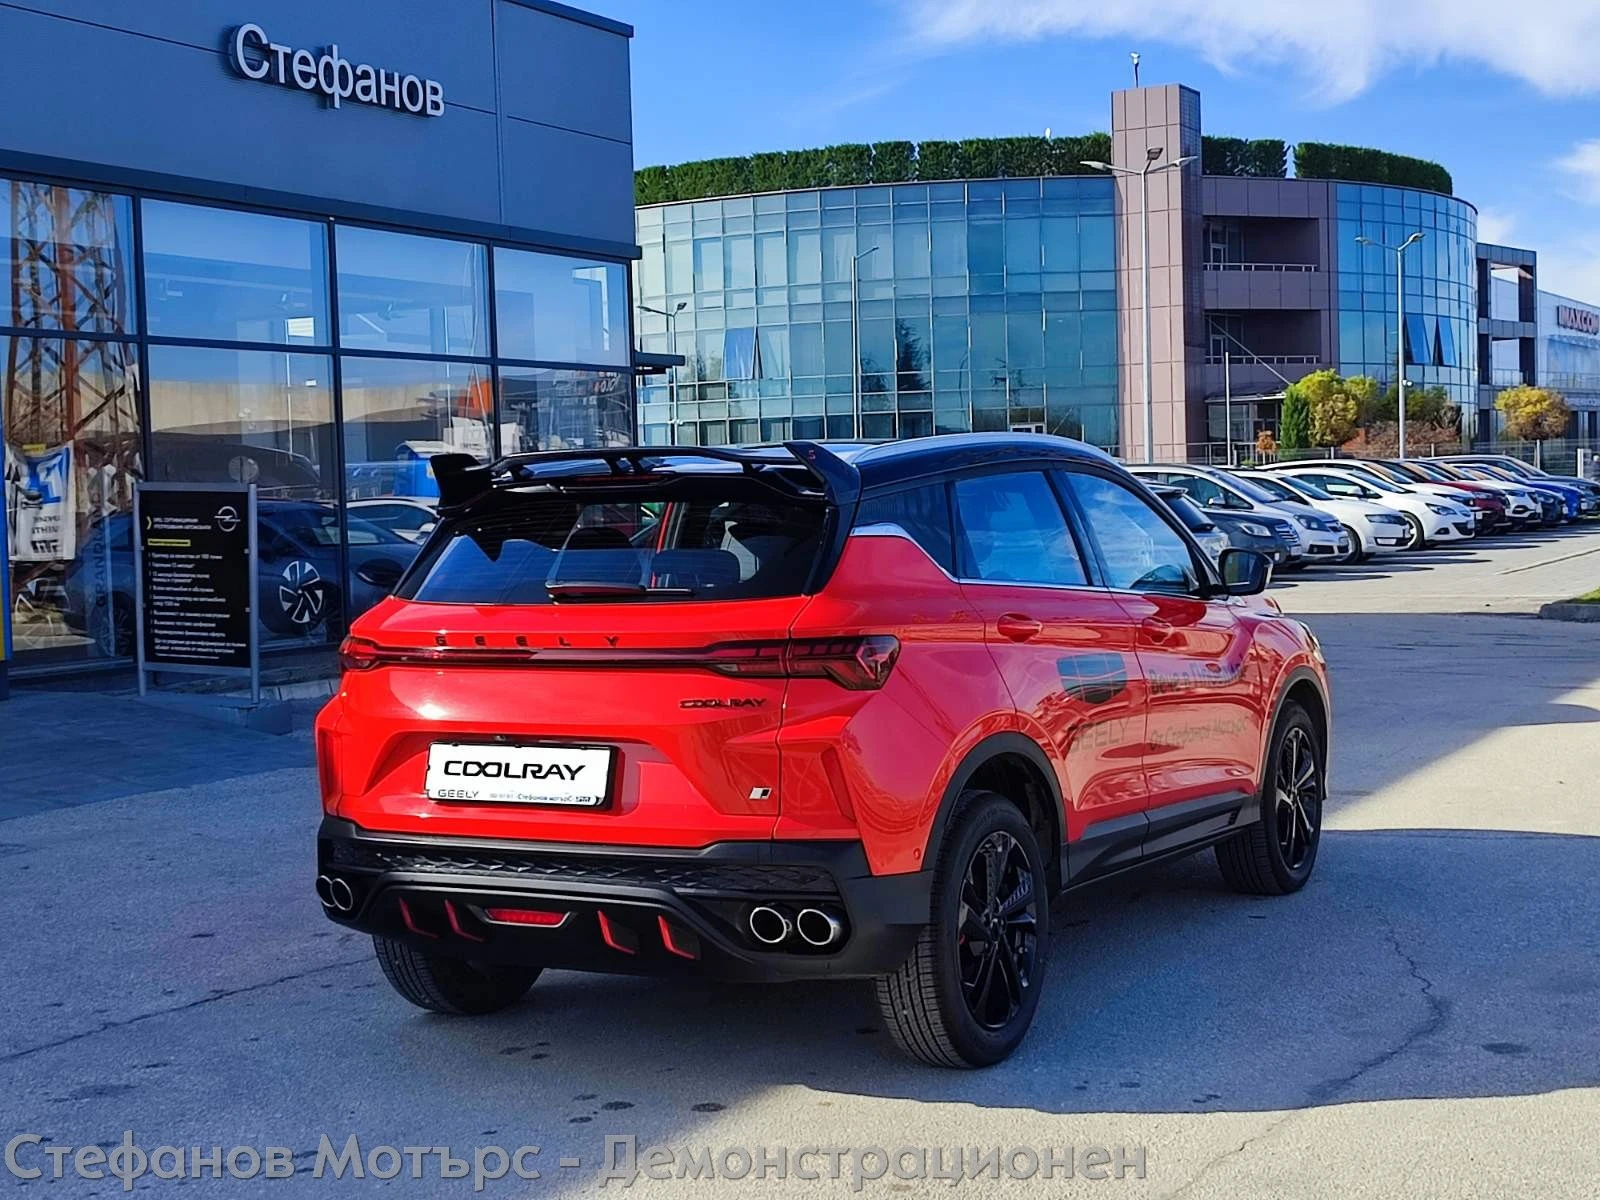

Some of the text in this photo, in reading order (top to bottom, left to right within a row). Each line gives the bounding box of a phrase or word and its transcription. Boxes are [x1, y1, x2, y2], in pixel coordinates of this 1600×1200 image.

[231, 22, 445, 117] Стефанов
[434, 635, 620, 648] GEELY
[679, 698, 767, 709] COOLRAY
[443, 760, 586, 781] COOLRAY
[437, 789, 480, 799] GEELY
